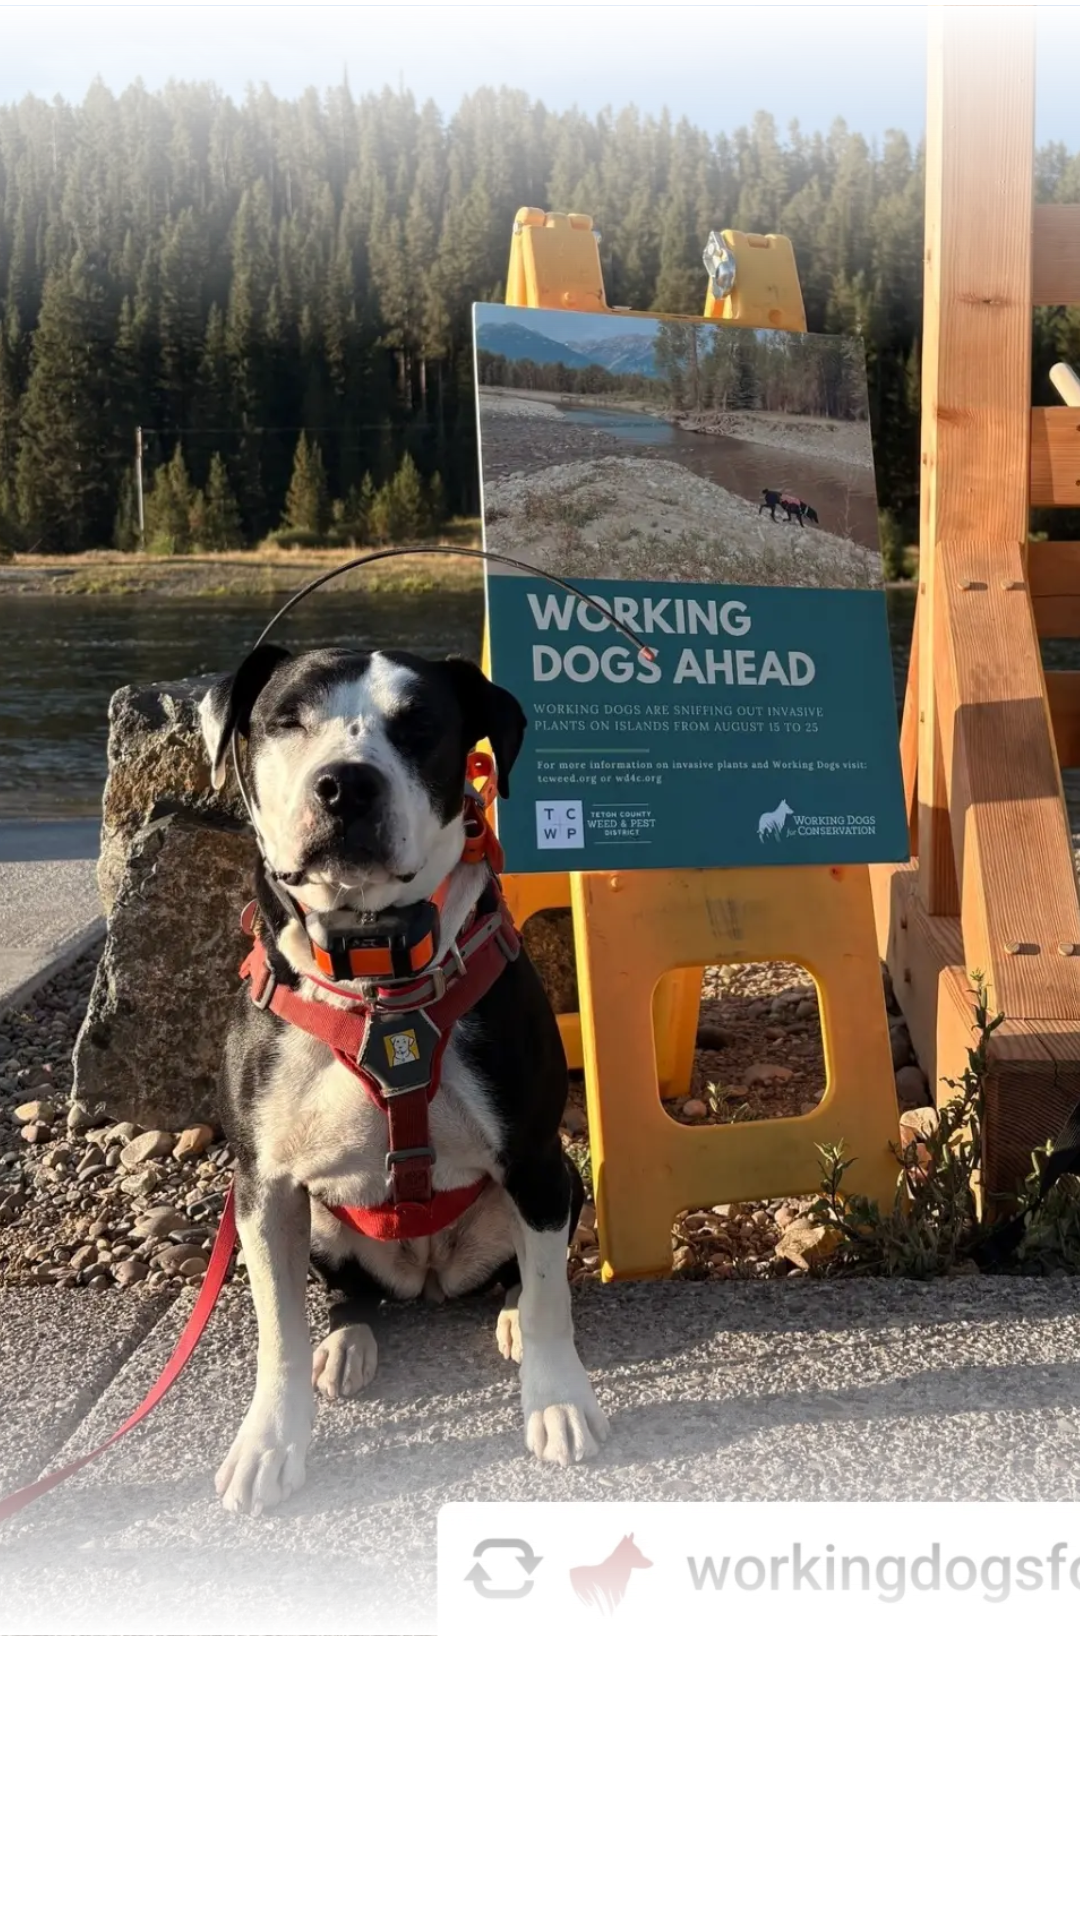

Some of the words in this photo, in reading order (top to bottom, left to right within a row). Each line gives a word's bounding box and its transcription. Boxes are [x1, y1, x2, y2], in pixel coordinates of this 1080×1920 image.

[526, 593, 752, 637] WORKING
[531, 644, 662, 684] DOGS
[672, 648, 816, 687] AHEAD
[533, 703, 600, 715] WORKING
[604, 704, 642, 715] DOGS
[645, 704, 670, 715] ARE
[673, 705, 733, 716] SNIFFING
[736, 705, 764, 716] OUT
[767, 706, 824, 717] INVASIVE
[534, 720, 586, 731] PLANTS
[589, 720, 610, 731] ON
[614, 720, 670, 731] ISLANDS
[673, 721, 710, 732] FROM
[714, 721, 765, 732] AUGUST
[769, 721, 780, 732] 15
[783, 722, 801, 732] TO
[805, 722, 819, 733] 25
[537, 760, 556, 770] For
[559, 762, 587, 770] more
[589, 760, 653, 770] information
[655, 762, 669, 770] on
[672, 760, 714, 770] invasive
[717, 760, 749, 772] plants
[751, 760, 769, 770] and
[772, 760, 815, 772] Working
[817, 760, 840, 772] Dogs
[842, 760, 868, 770] visit:
[537, 773, 597, 785] tcweed.org
[600, 774, 612, 783] or
[615, 773, 663, 785] wd4c.org
[543, 808, 554, 820] T
[566, 807, 576, 820] C
[587, 819, 618, 829] WEED
[620, 819, 628, 828] &
[630, 818, 656, 828] PEST
[793, 815, 845, 826] WORKING
[847, 815, 876, 825] DOGS
[544, 827, 557, 840] W
[567, 827, 577, 840] P
[797, 826, 876, 836] CONSERVATION
